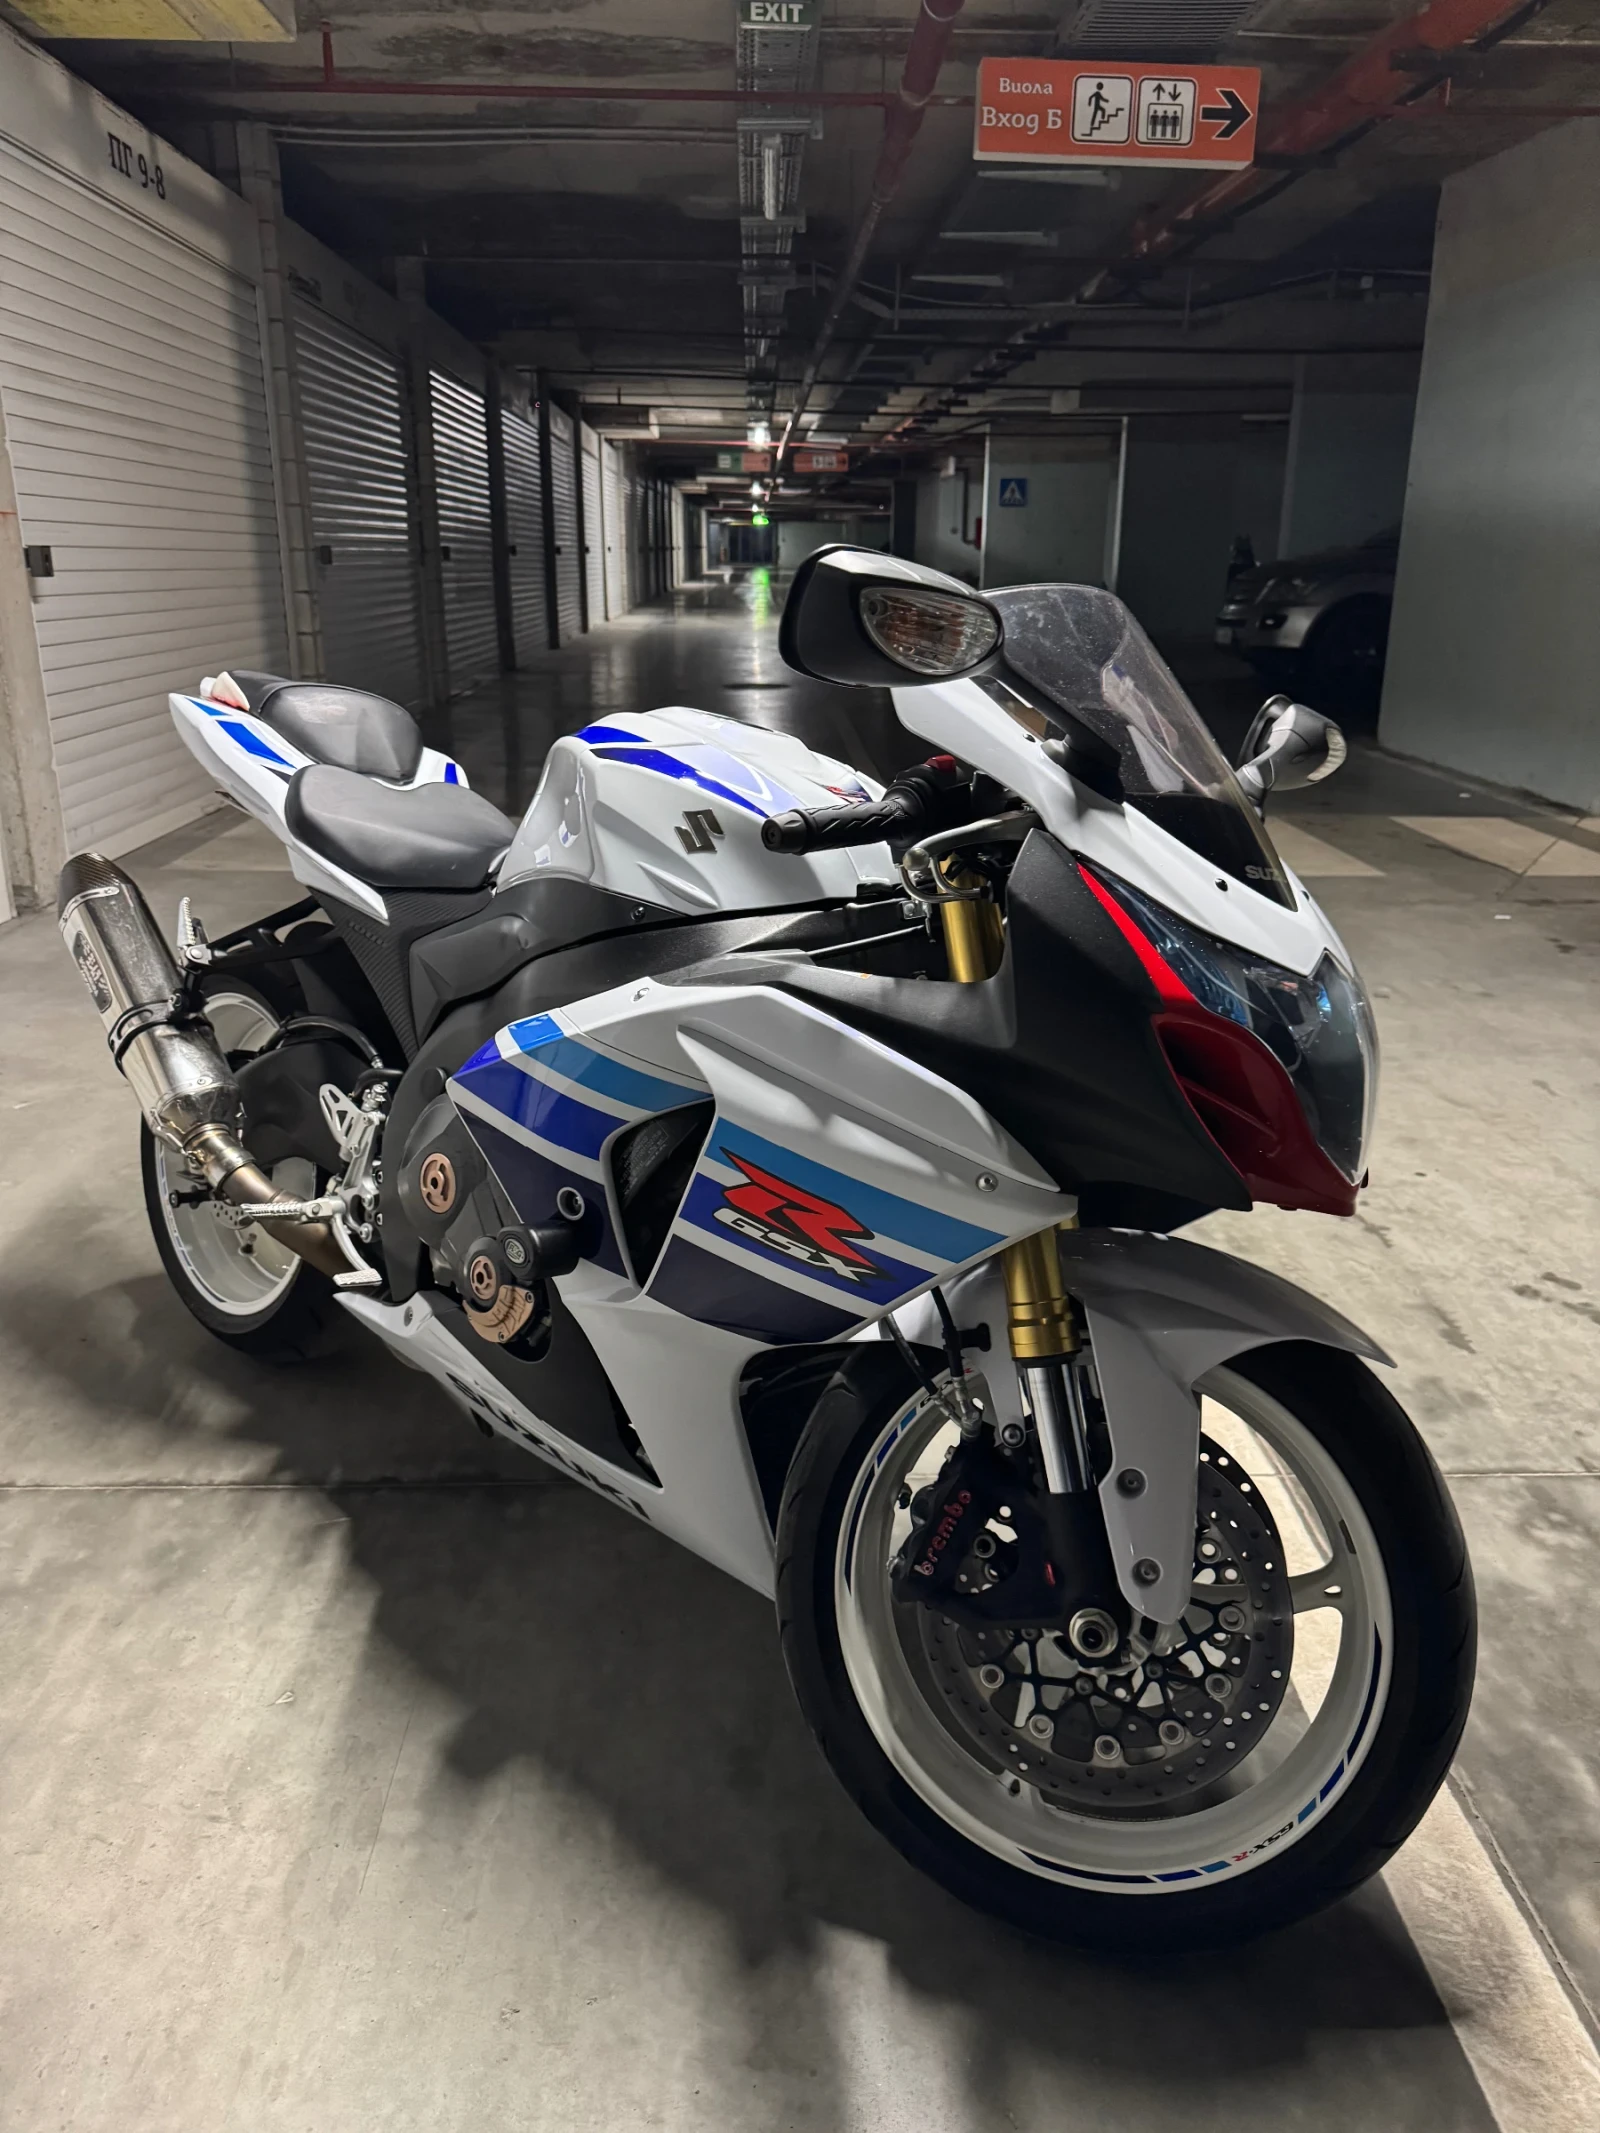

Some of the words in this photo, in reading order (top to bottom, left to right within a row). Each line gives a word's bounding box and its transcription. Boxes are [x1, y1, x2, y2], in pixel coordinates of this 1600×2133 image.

[749, 1, 804, 23] EXIT
[999, 77, 1054, 95] Виола
[980, 106, 1039, 135] Вход
[1046, 108, 1063, 129] Б
[107, 131, 133, 178] ПГ
[137, 153, 166, 200] 9-8
[713, 1207, 877, 1282] GSX
[913, 1489, 971, 1576] brembo
[1231, 1821, 1294, 1862] GSX-R
